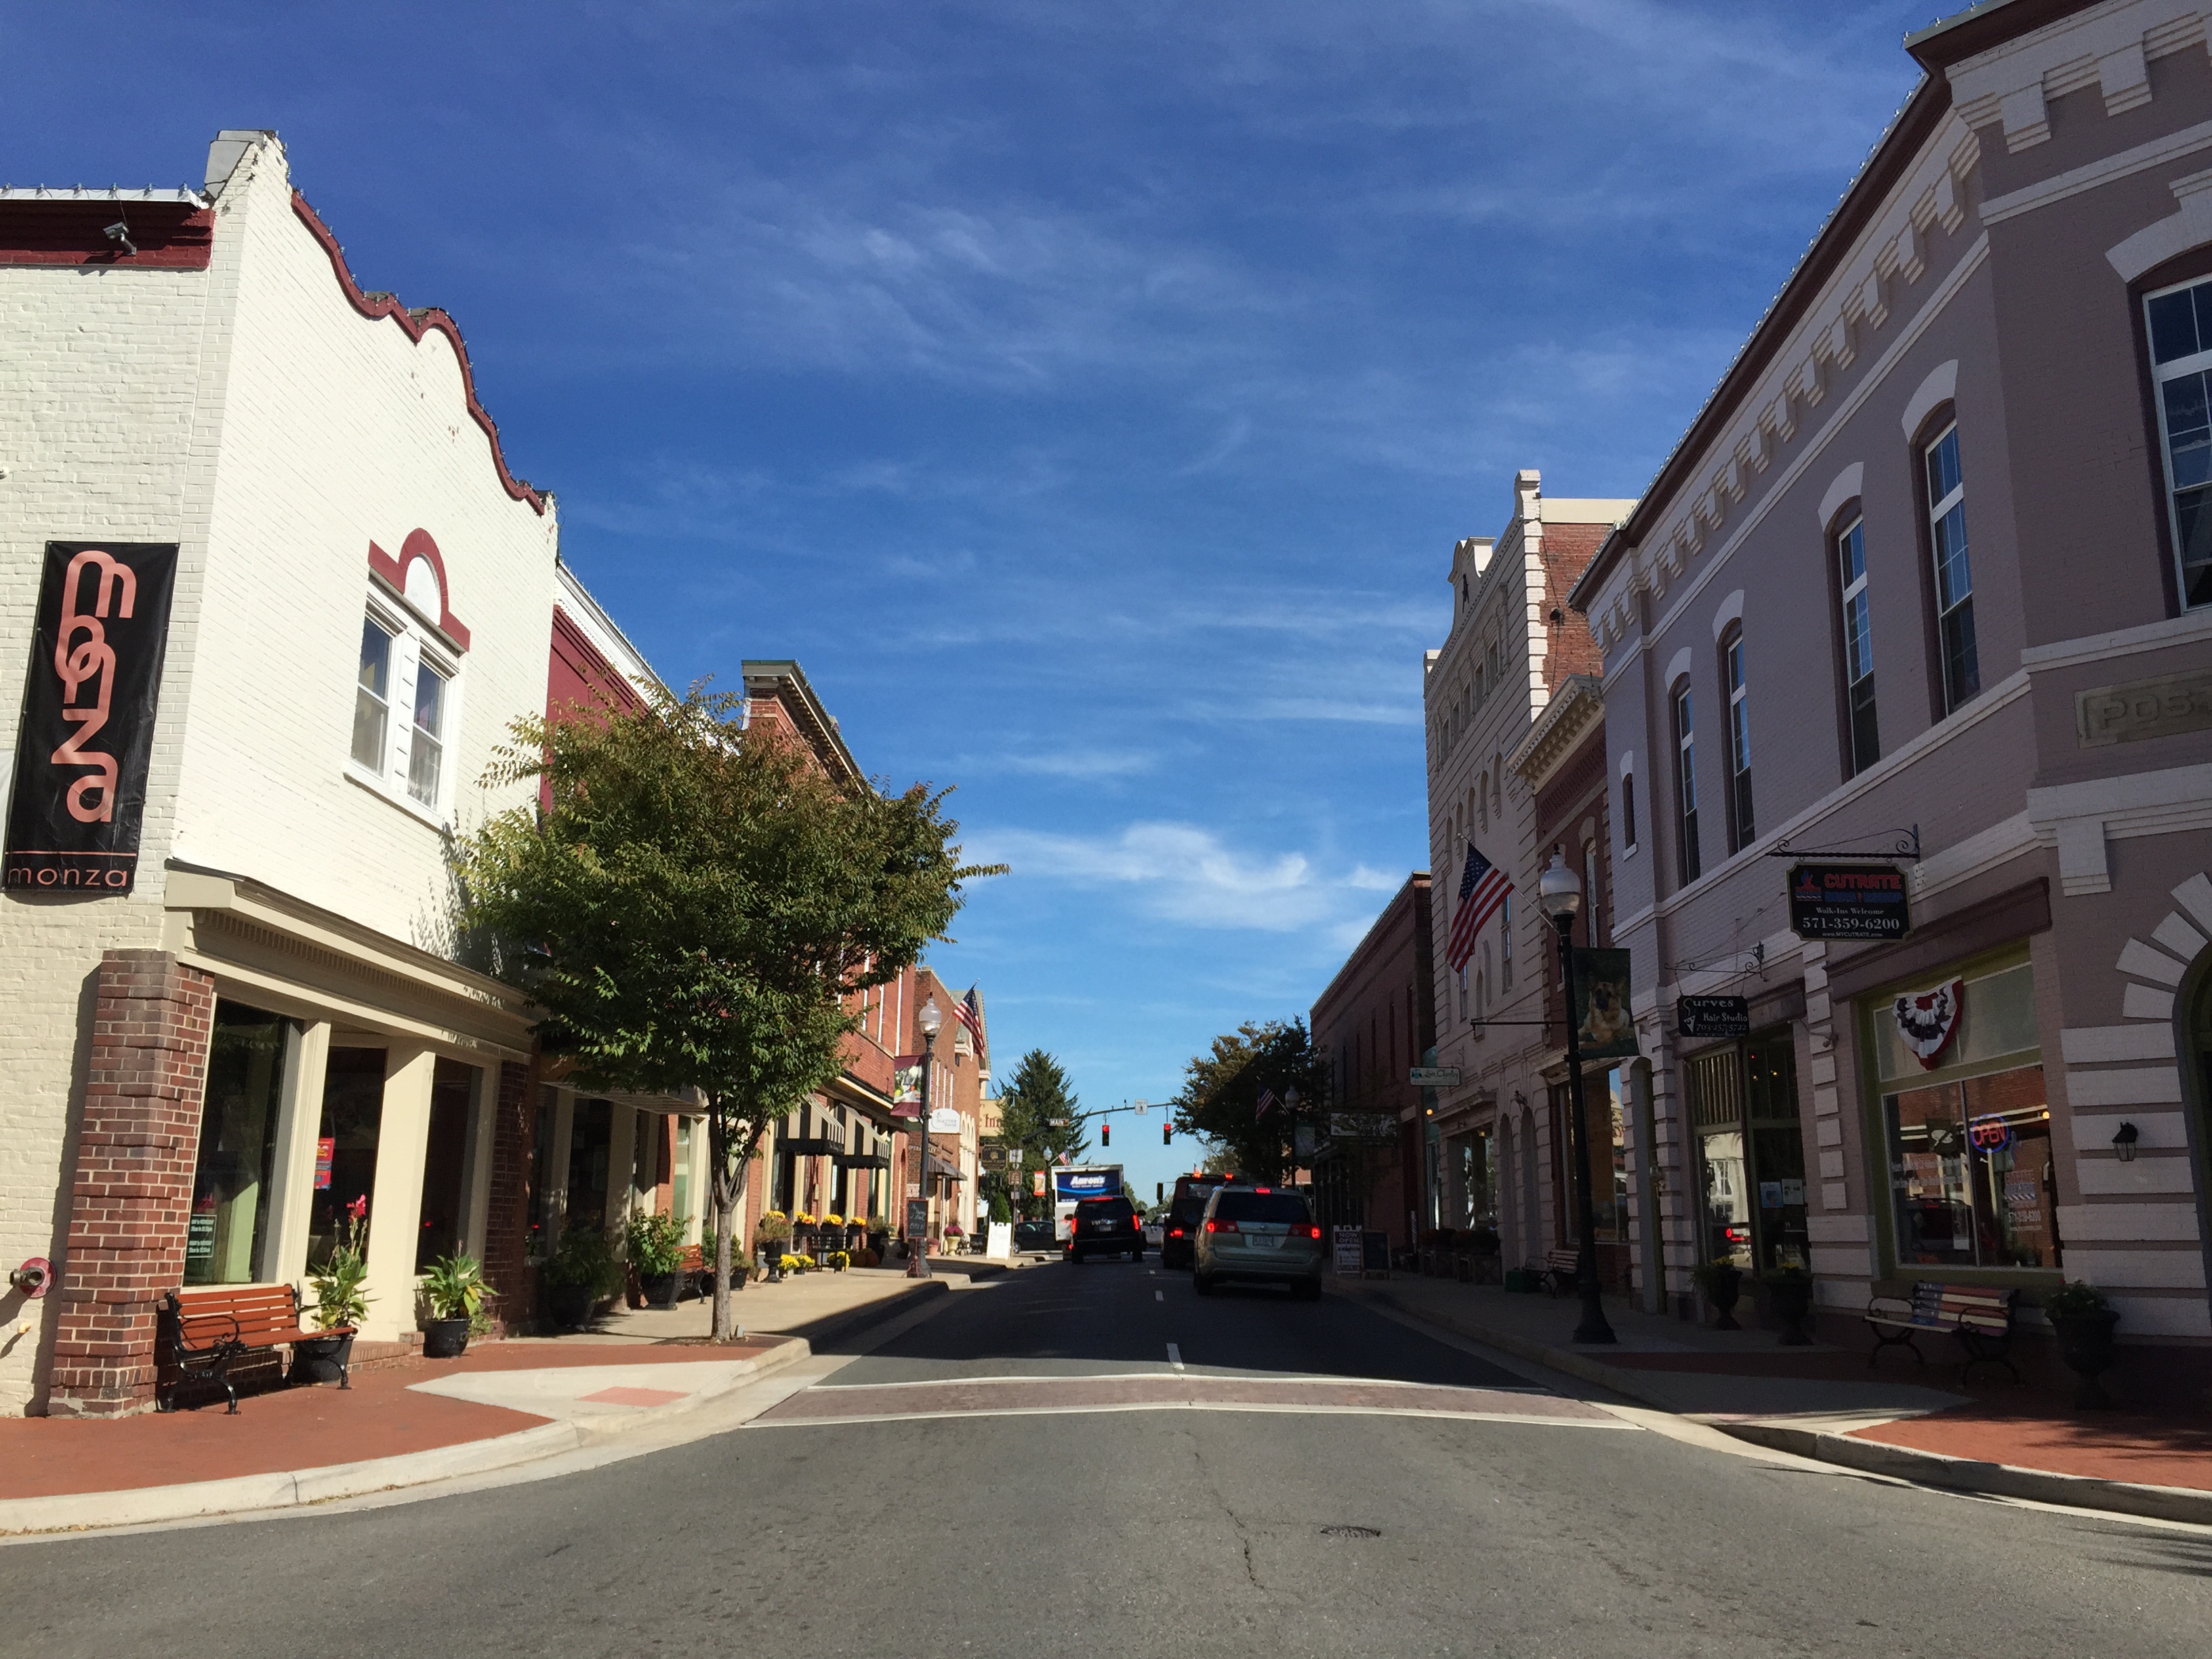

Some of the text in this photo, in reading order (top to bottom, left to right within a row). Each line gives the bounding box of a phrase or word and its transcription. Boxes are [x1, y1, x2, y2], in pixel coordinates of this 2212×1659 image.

[51, 550, 137, 823] monza
[8, 867, 128, 887] monza
[1824, 873, 1902, 889] CUTRATE
[1816, 907, 1885, 915] Walk-Ins Welcome
[1803, 917, 1900, 930] 571-359-6200
[1702, 1012, 1748, 1022] Hair Studio
[1972, 1122, 2007, 1145] OPEN
[1070, 1175, 1106, 1185] Aaron's
